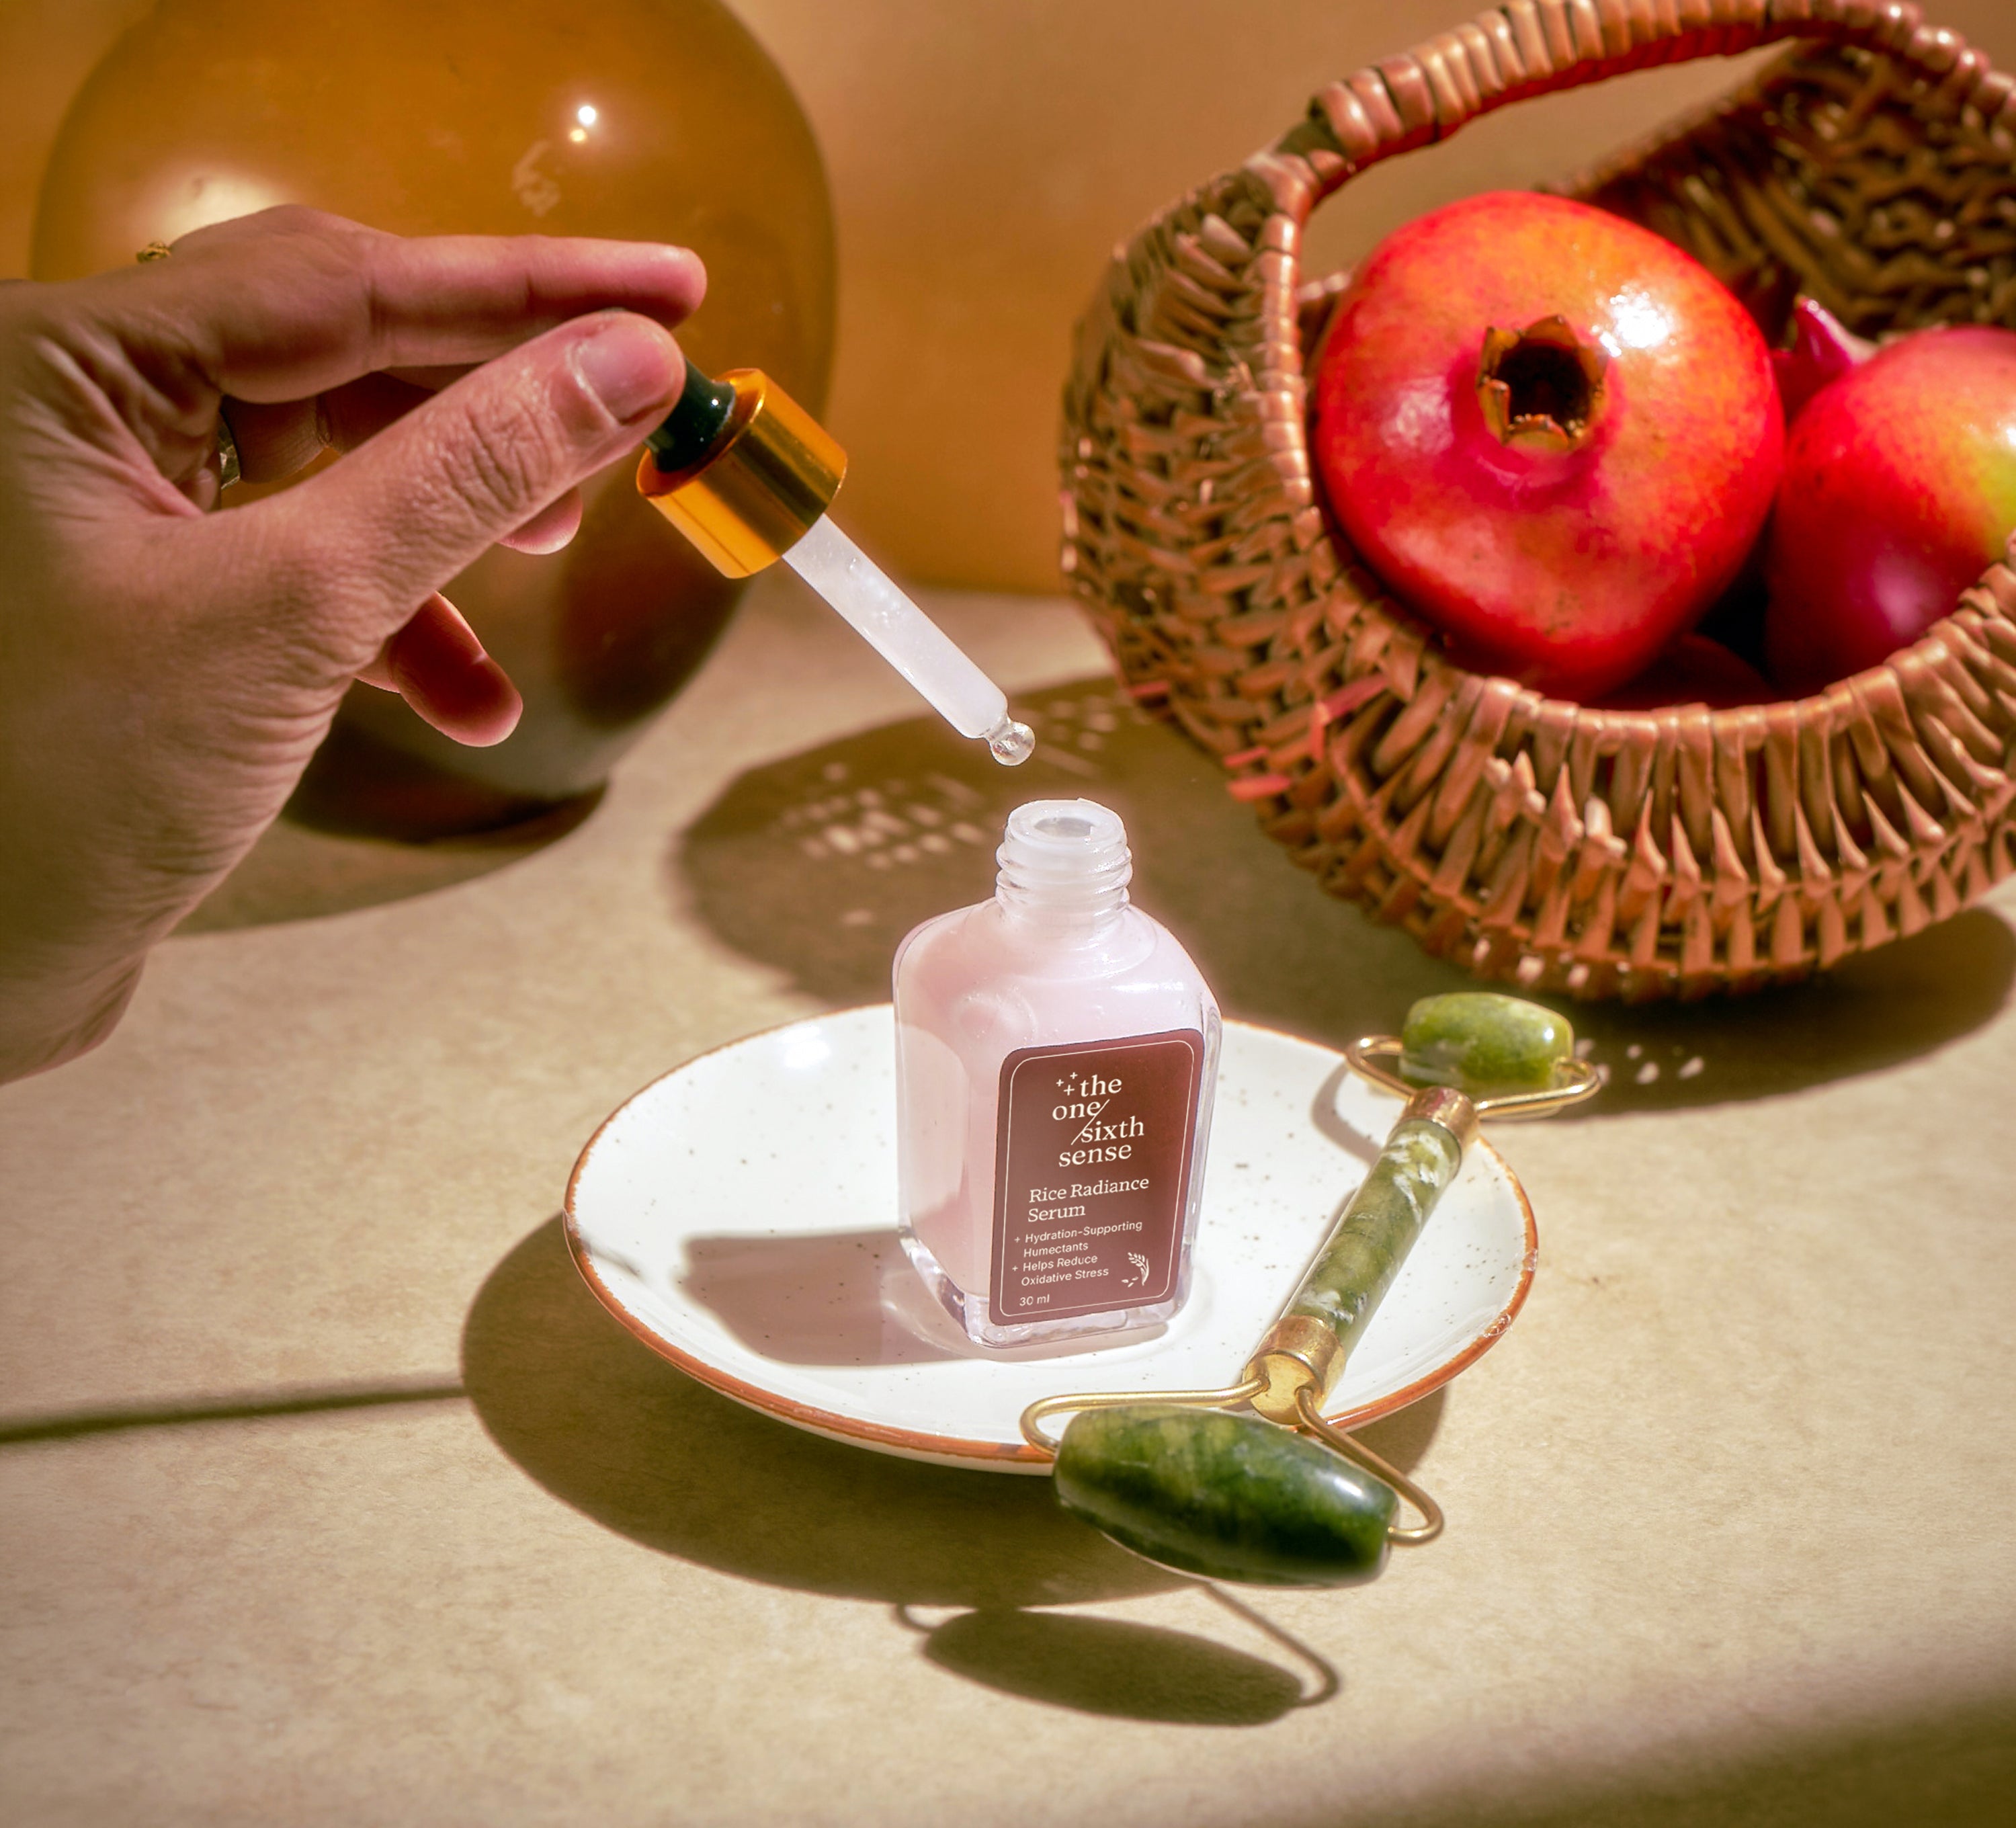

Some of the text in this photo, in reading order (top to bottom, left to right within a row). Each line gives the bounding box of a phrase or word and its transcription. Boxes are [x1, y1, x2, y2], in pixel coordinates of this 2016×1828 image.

[1080, 1075, 1122, 1097] the
[1081, 1116, 1144, 1143] sixth
[1058, 1145, 1132, 1167] sense
[1029, 1178, 1150, 1203] Rice Radiance
[1027, 1205, 1086, 1222] Serum
[1025, 1221, 1143, 1245] Hydration-Supporting
[1023, 1242, 1089, 1258] Humectants
[1023, 1255, 1098, 1272] Helps Reduce
[1021, 1268, 1109, 1286] Oxidative Stress
[1019, 1294, 1050, 1306] 30 ml
